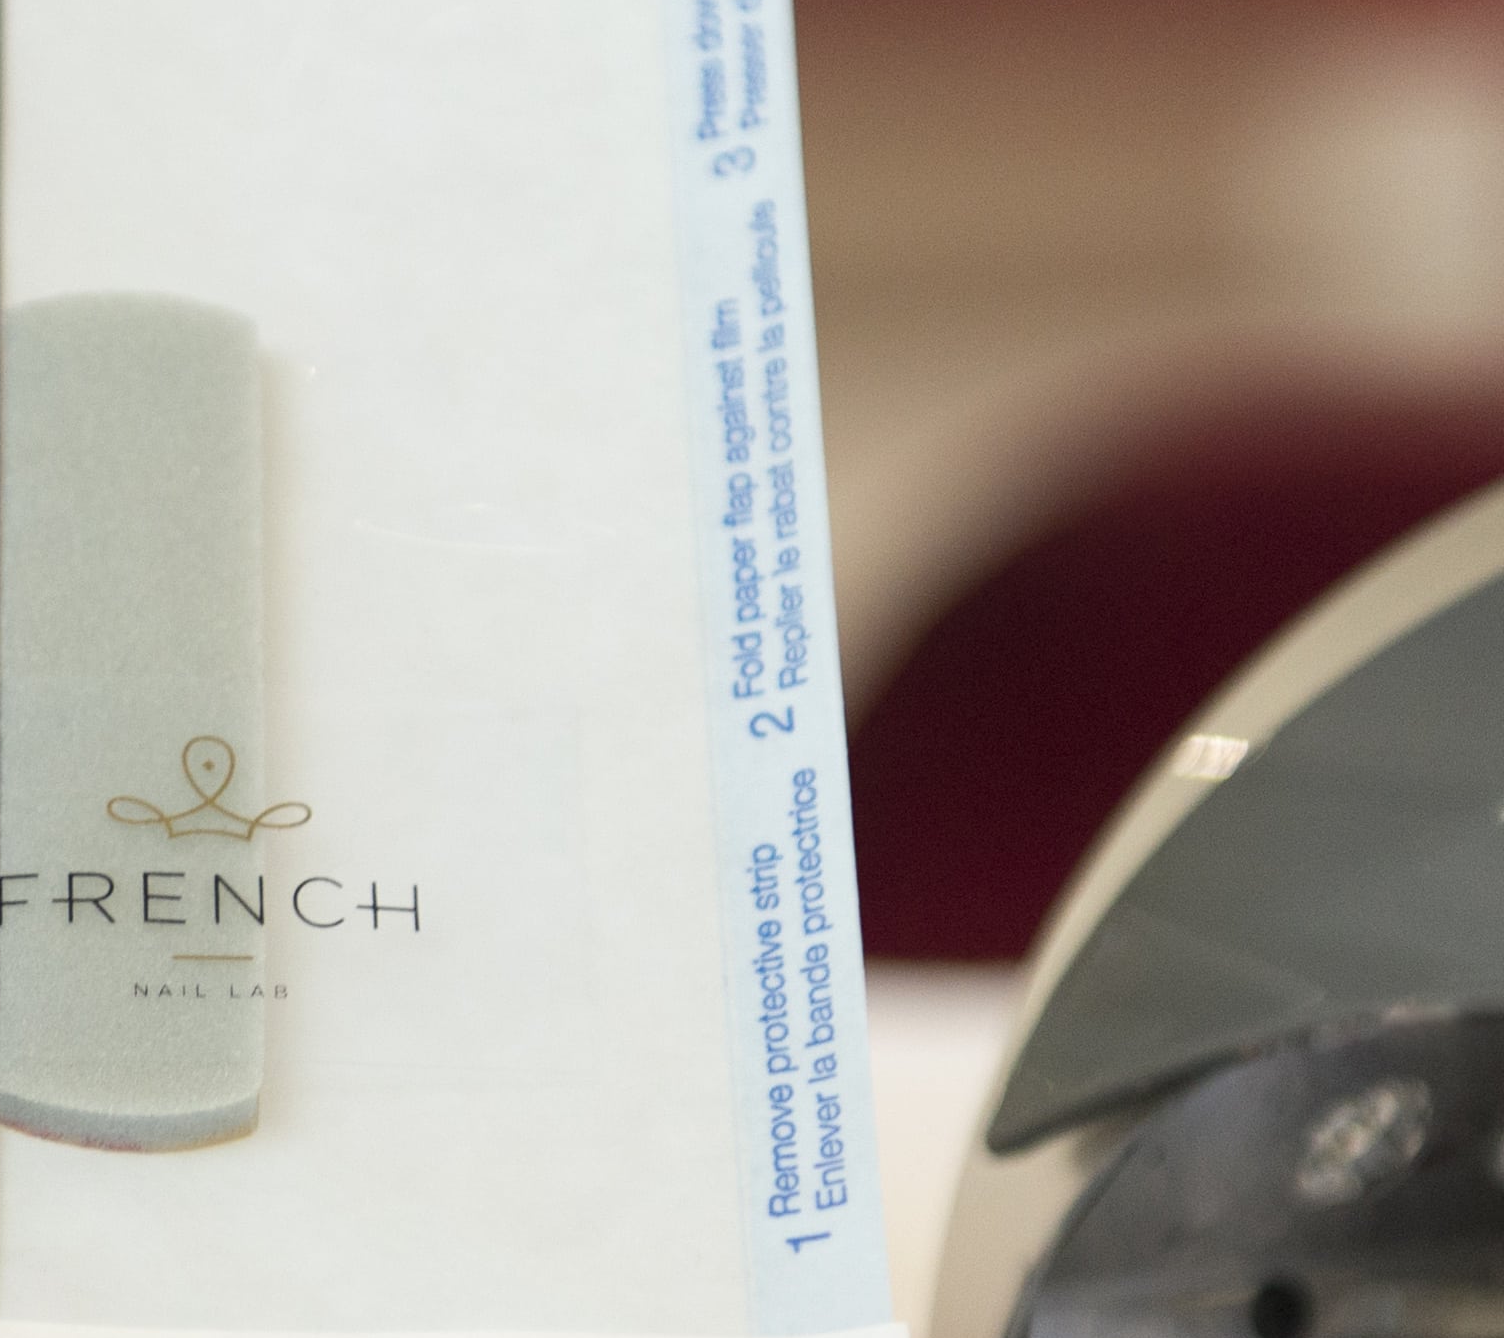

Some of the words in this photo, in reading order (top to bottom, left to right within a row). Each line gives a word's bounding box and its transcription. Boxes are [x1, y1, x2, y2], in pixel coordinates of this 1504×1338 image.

[695, 60, 726, 140] Press
[709, 146, 756, 178] 3
[749, 202, 787, 316] pellicule
[711, 299, 740, 350] film
[757, 322, 784, 351] la
[715, 359, 750, 463] against
[761, 358, 792, 451] contre
[722, 472, 755, 527] flap
[768, 461, 799, 538] rabat
[730, 538, 764, 622] paper
[773, 544, 800, 570] le
[732, 632, 766, 699] Fold
[776, 585, 813, 688] Replier
[749, 706, 795, 738] 2
[748, 843, 784, 909] strip
[789, 767, 833, 934] protectrice
[133, 982, 206, 999] NAIL
[230, 983, 288, 999] LAB
[753, 921, 798, 1073] protective
[800, 944, 835, 1046] bande
[809, 1053, 837, 1083] la
[769, 1084, 801, 1217] Remove
[810, 1092, 848, 1210] Enlever
[786, 1230, 831, 1254] 1
